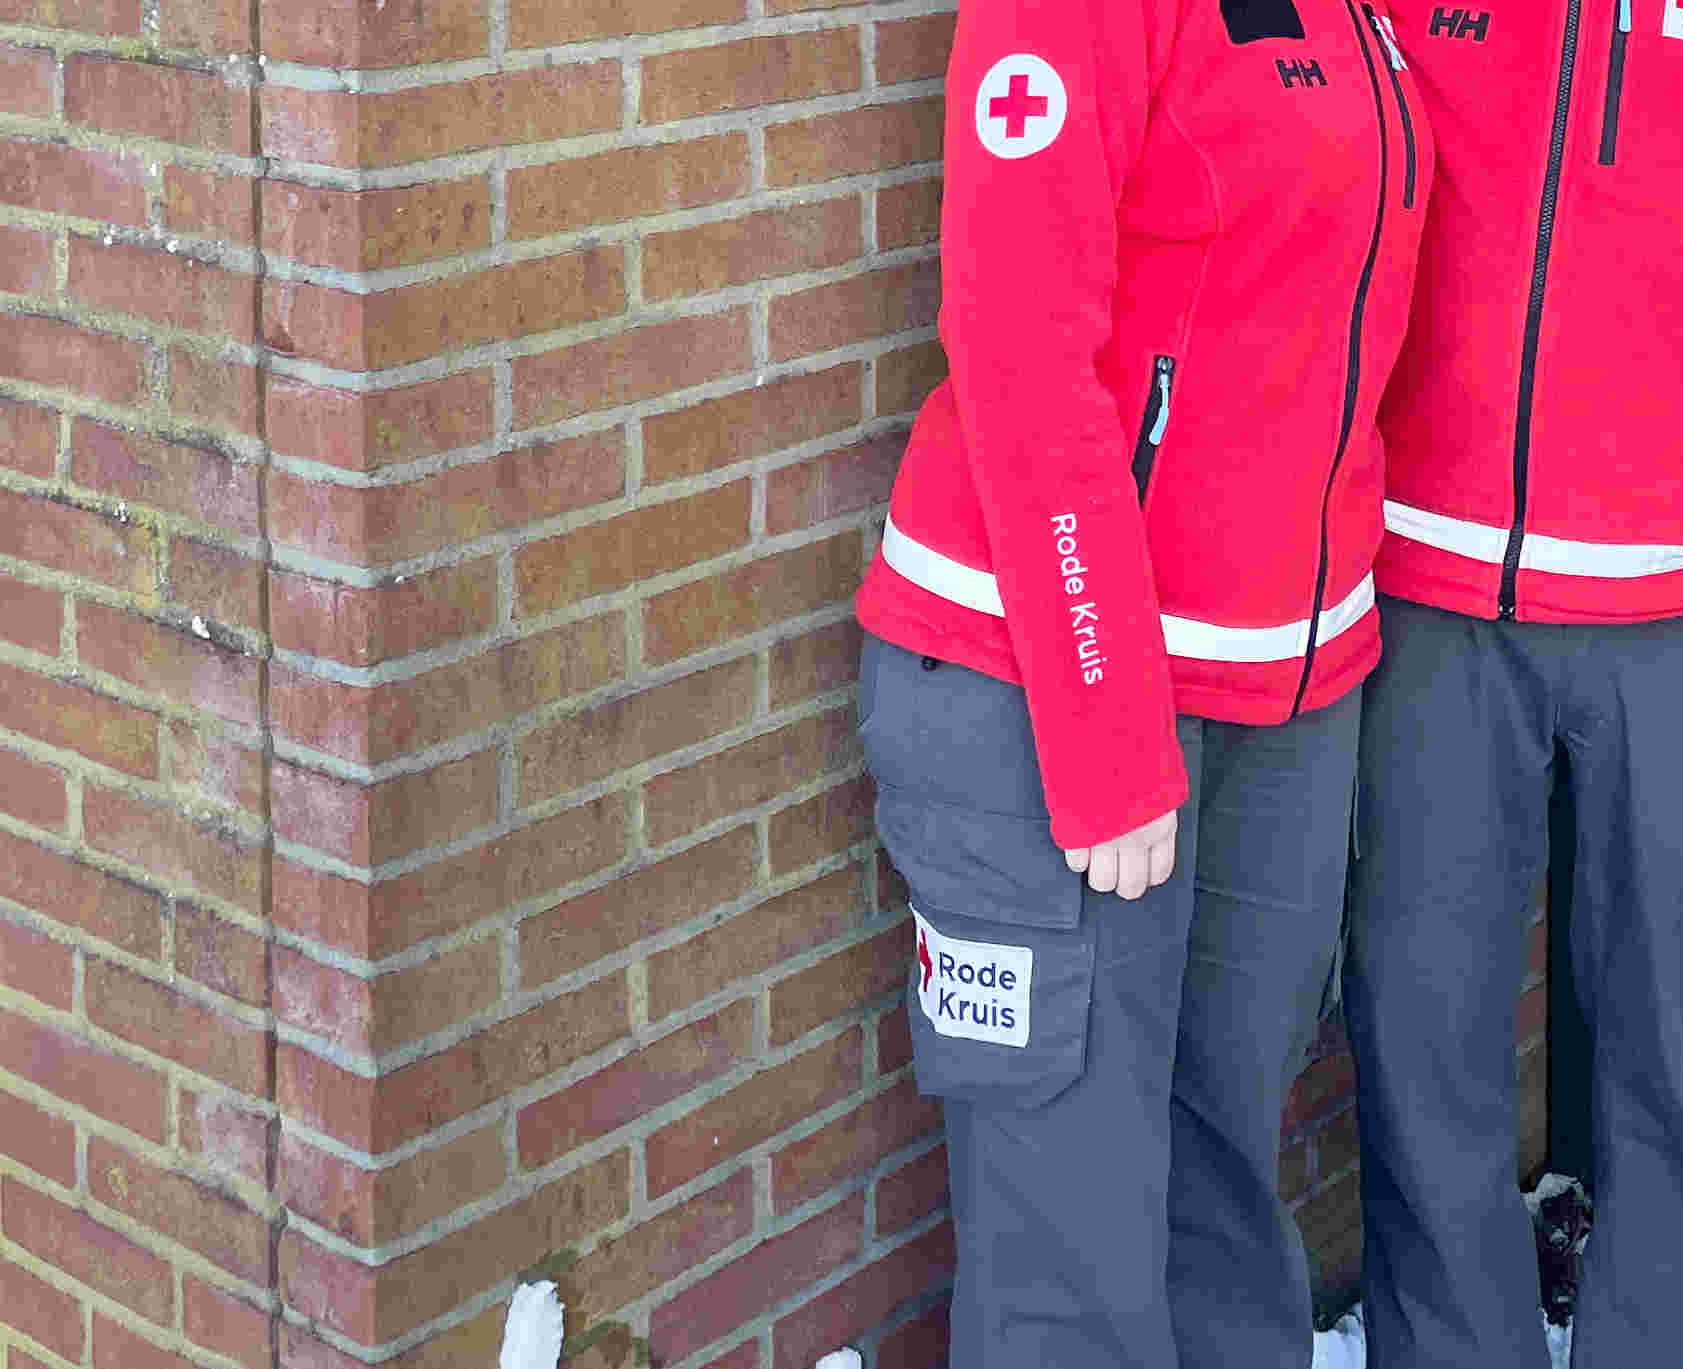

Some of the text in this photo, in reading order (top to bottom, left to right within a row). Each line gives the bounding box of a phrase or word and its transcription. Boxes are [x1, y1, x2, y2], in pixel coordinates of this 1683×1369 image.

[1429, 7, 1490, 42] HH
[1275, 58, 1327, 89] HH
[1050, 512, 1104, 685] Rode Kruis
[938, 951, 1017, 992] Rode
[937, 987, 1017, 1029] Kruis
